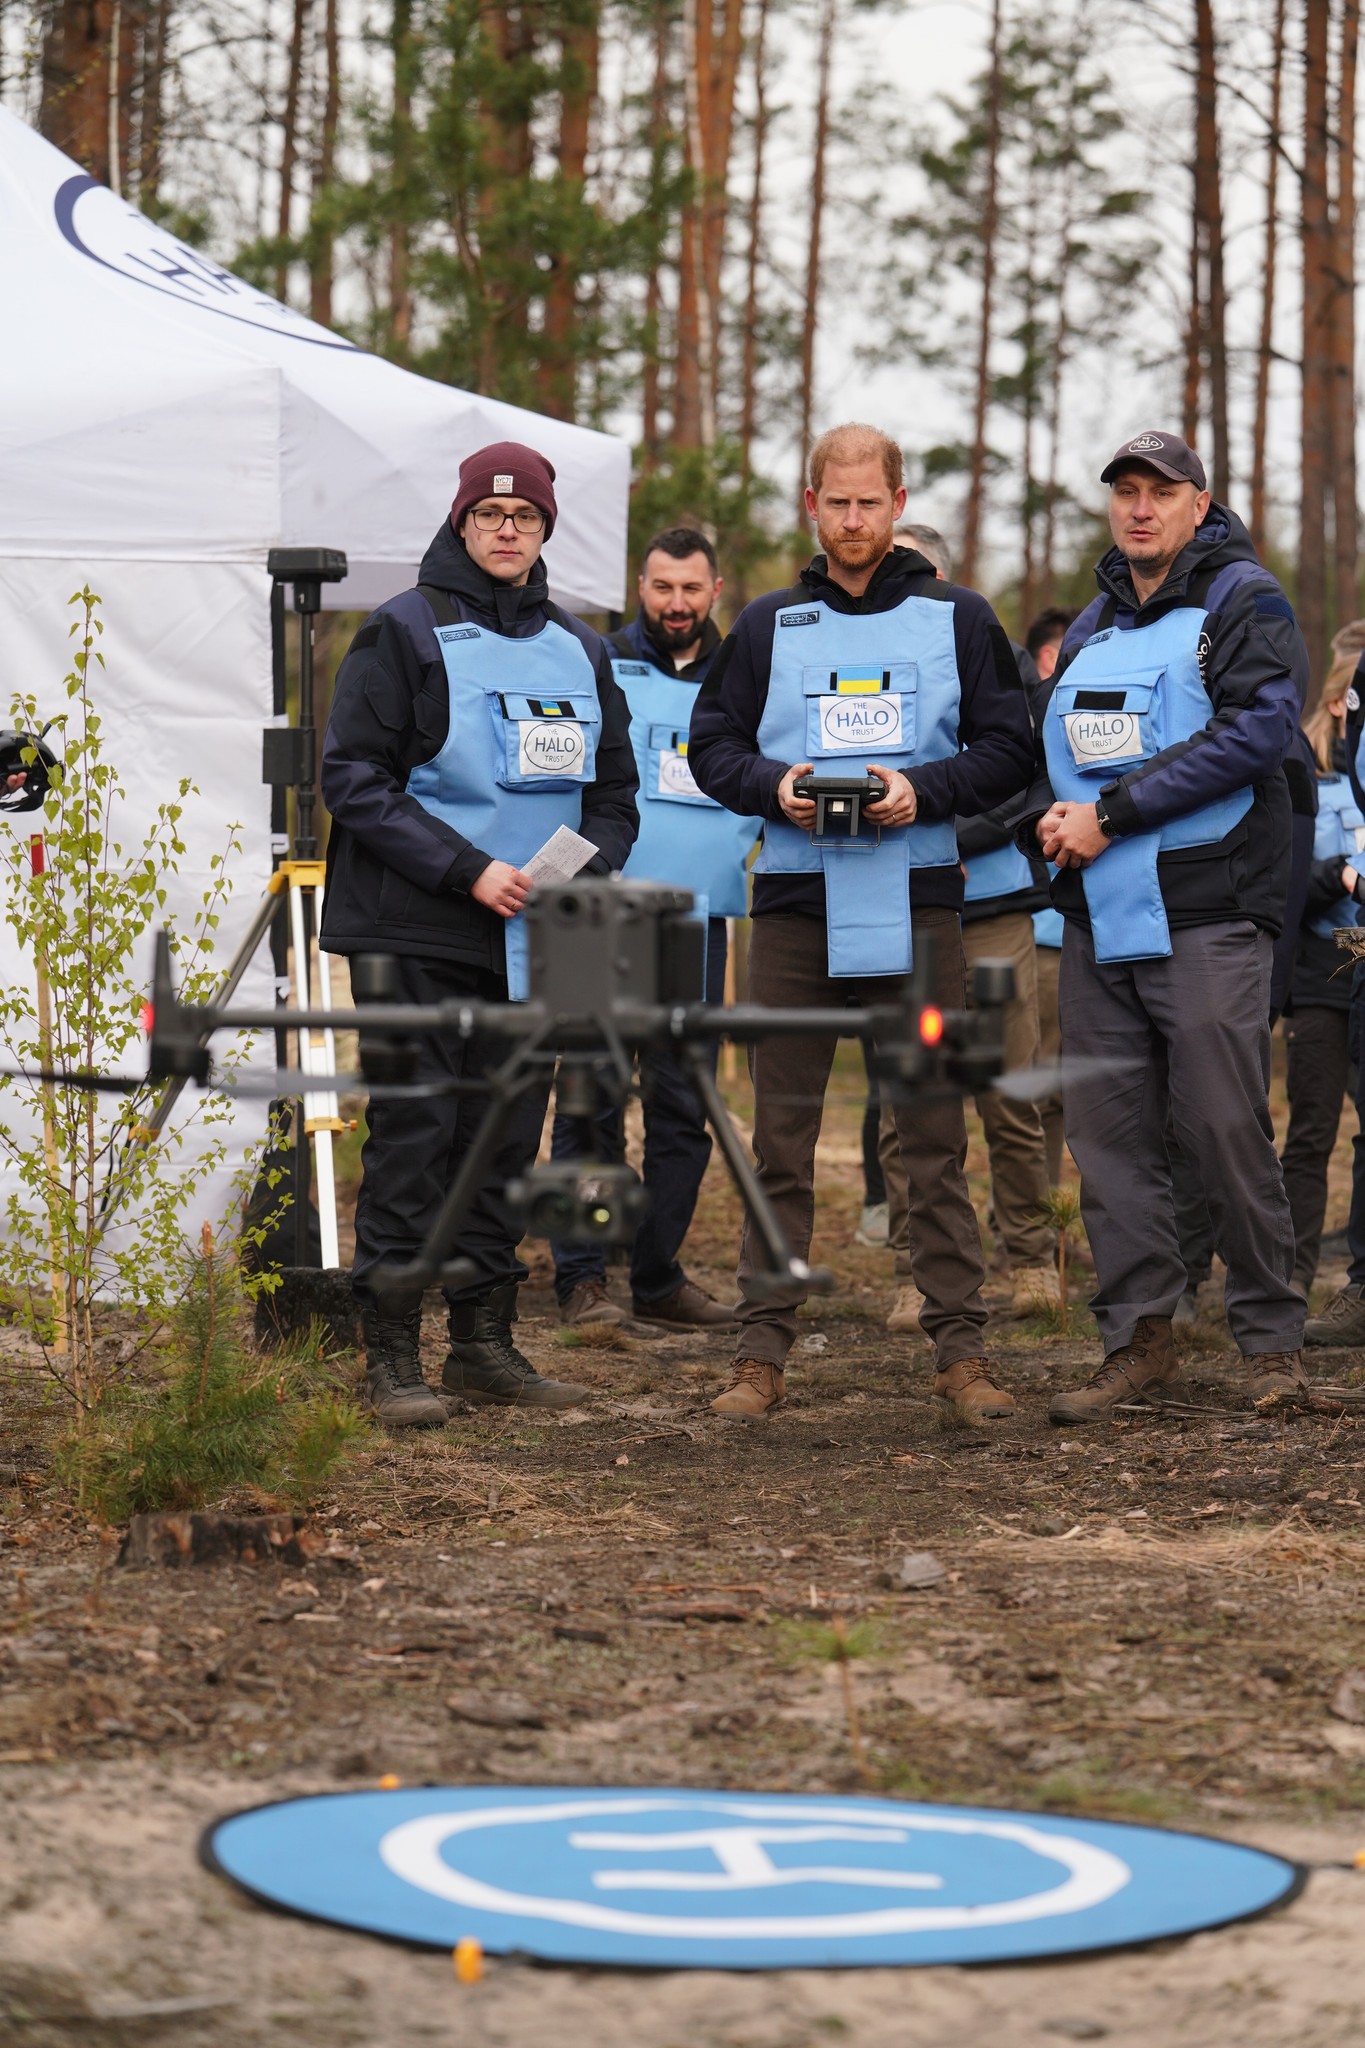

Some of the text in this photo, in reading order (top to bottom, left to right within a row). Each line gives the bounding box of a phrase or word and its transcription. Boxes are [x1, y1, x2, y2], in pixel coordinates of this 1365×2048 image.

[1133, 439, 1159, 448] HALO
[836, 710, 889, 728] HALO
[851, 728, 875, 736] TRUST
[1079, 719, 1124, 740] HALO
[535, 737, 576, 752] HALO
[1091, 738, 1113, 748] TRUST
[544, 755, 564, 763] TRUST
